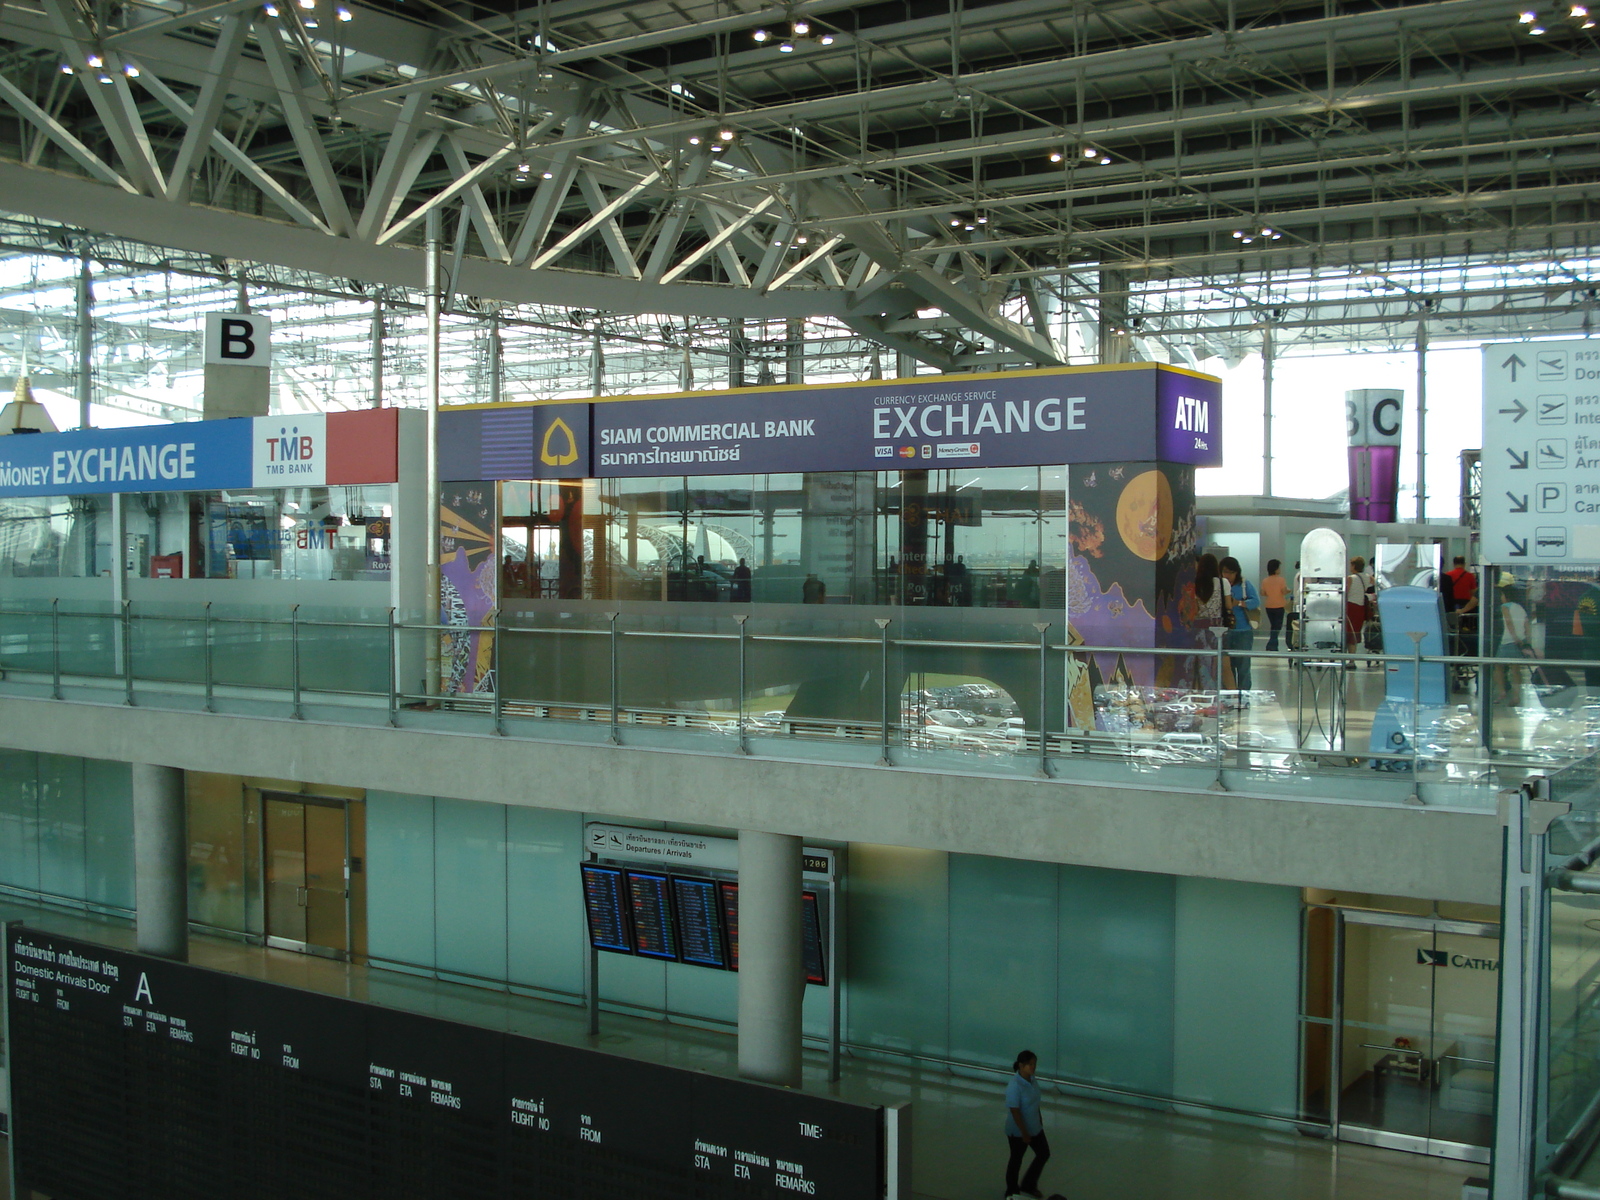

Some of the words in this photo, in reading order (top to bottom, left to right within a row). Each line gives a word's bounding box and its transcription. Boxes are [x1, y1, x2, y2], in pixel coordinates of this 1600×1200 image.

[221, 318, 255, 359] B
[874, 395, 916, 405] CURRENCY
[918, 393, 962, 403] EXCHANGE
[964, 390, 997, 400] SERVICE
[873, 397, 1086, 438] EXCHANGE
[1175, 396, 1209, 433] ATM
[1373, 398, 1400, 436] C
[601, 428, 642, 445] SIAM
[646, 422, 760, 443] COMMERCIAL
[764, 419, 815, 438] BANK
[266, 427, 313, 461] TMB
[601, 444, 741, 466] ธนาคารไทยพาณิชย์
[1575, 435, 1600, 454] ผู้โด
[0, 462, 50, 486] MONEY
[53, 443, 196, 485] EXCHANGE
[266, 465, 285, 475] TMB
[288, 463, 313, 473] BANK
[1542, 487, 1560, 509] P
[626, 843, 661, 854] Departures
[667, 848, 692, 858] Arrivals
[804, 859, 827, 868] 1200
[15, 960, 54, 980] Domestic
[56, 971, 87, 988] Arrivals
[88, 978, 111, 994] Door
[16, 988, 30, 1000] FLIGHT
[32, 992, 39, 1003] NO
[135, 972, 153, 1005] A
[57, 998, 70, 1011] FROM
[123, 1016, 133, 1027] STA
[146, 1021, 156, 1033] ETA
[170, 1027, 193, 1043] REMARKS
[231, 1042, 249, 1056] FLIGHT
[251, 1048, 261, 1060] NO
[283, 1055, 299, 1069] FROM
[369, 1077, 382, 1090] STA
[400, 1084, 412, 1097] ETA
[431, 1091, 461, 1109] REMARKS
[511, 1111, 534, 1127] FLIGHT
[538, 1118, 550, 1131] NO
[799, 1122, 823, 1139] TIME:
[580, 1127, 601, 1143] FROM
[694, 1155, 710, 1170] STA
[734, 1164, 750, 1180] ETA
[776, 1174, 815, 1195] REMARKS
